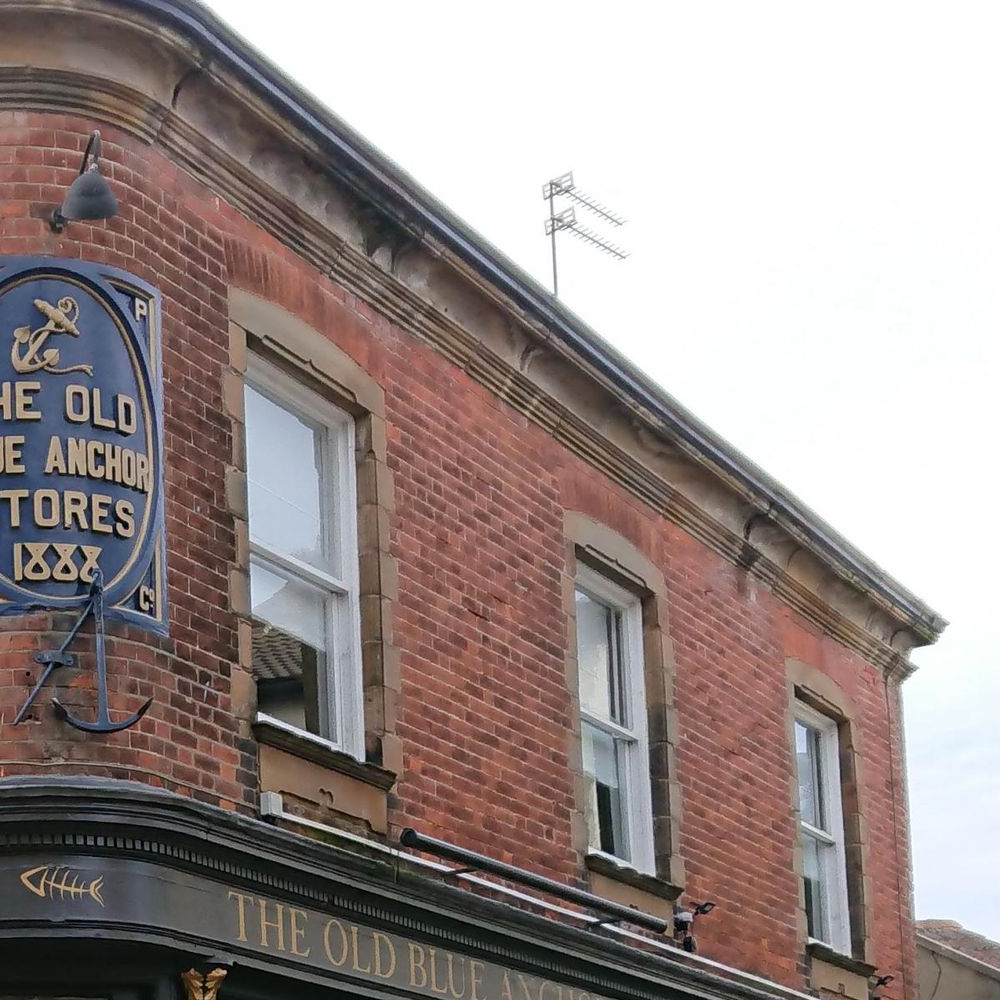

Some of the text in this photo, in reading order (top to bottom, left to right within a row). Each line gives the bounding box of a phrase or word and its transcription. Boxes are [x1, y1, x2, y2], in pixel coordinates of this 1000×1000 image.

[134, 297, 148, 322] P
[65, 384, 137, 435] OLD
[45, 436, 150, 494] ANCHOR
[13, 543, 103, 583] 1888
[227, 890, 311, 958] THE
[323, 919, 397, 979] OLD
